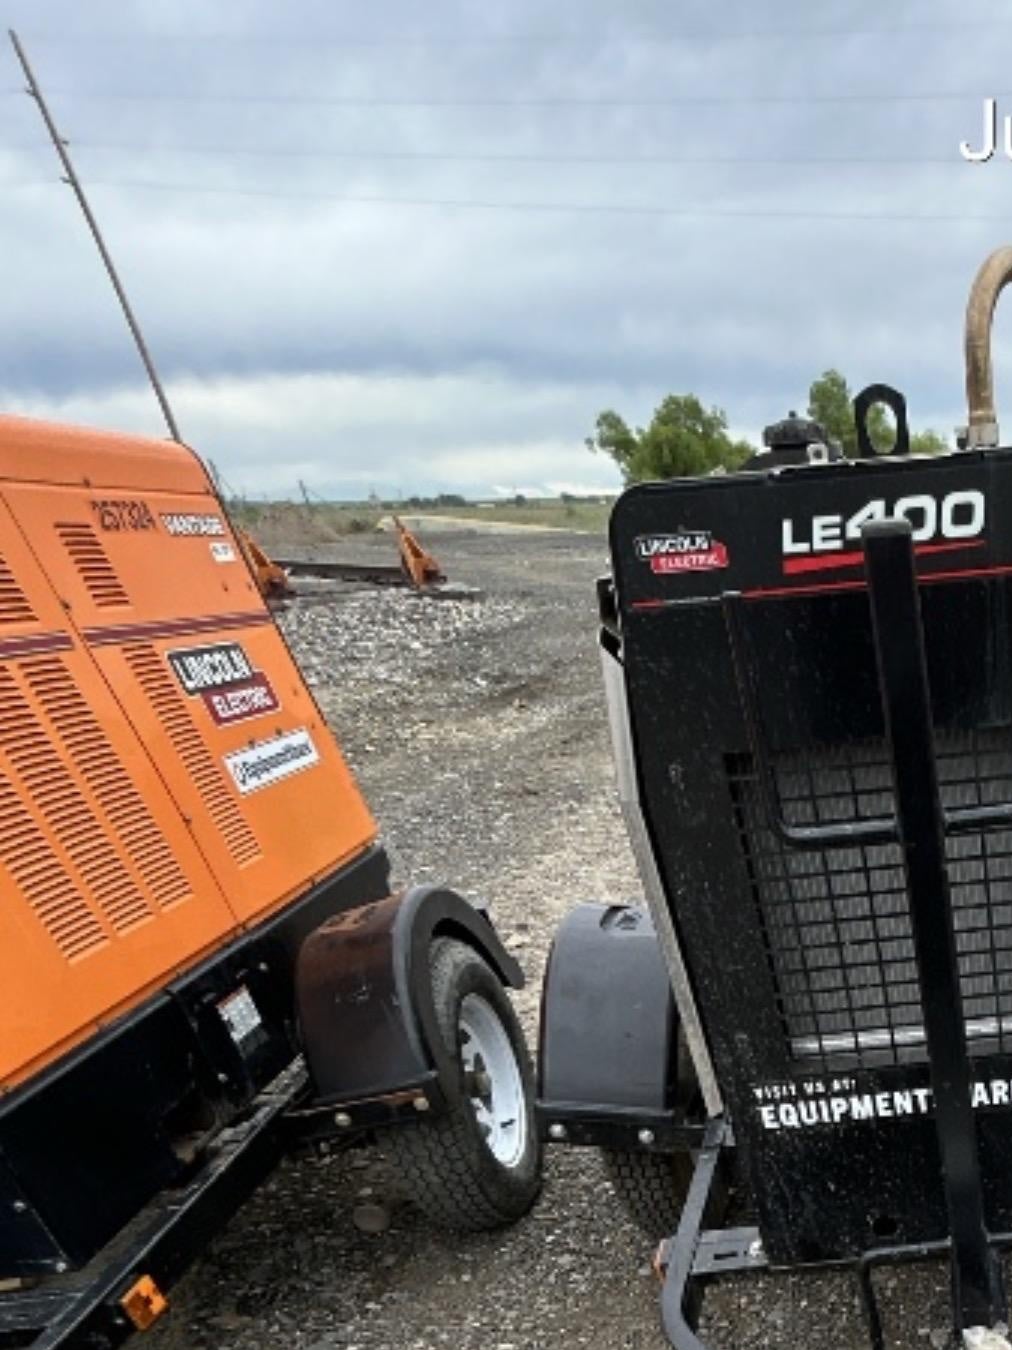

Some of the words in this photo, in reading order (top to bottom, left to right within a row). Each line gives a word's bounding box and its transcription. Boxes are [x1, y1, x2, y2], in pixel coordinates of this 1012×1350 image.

[782, 489, 985, 554] LE400
[640, 535, 709, 556] LINCOLN
[172, 650, 252, 688] LINCOLN
